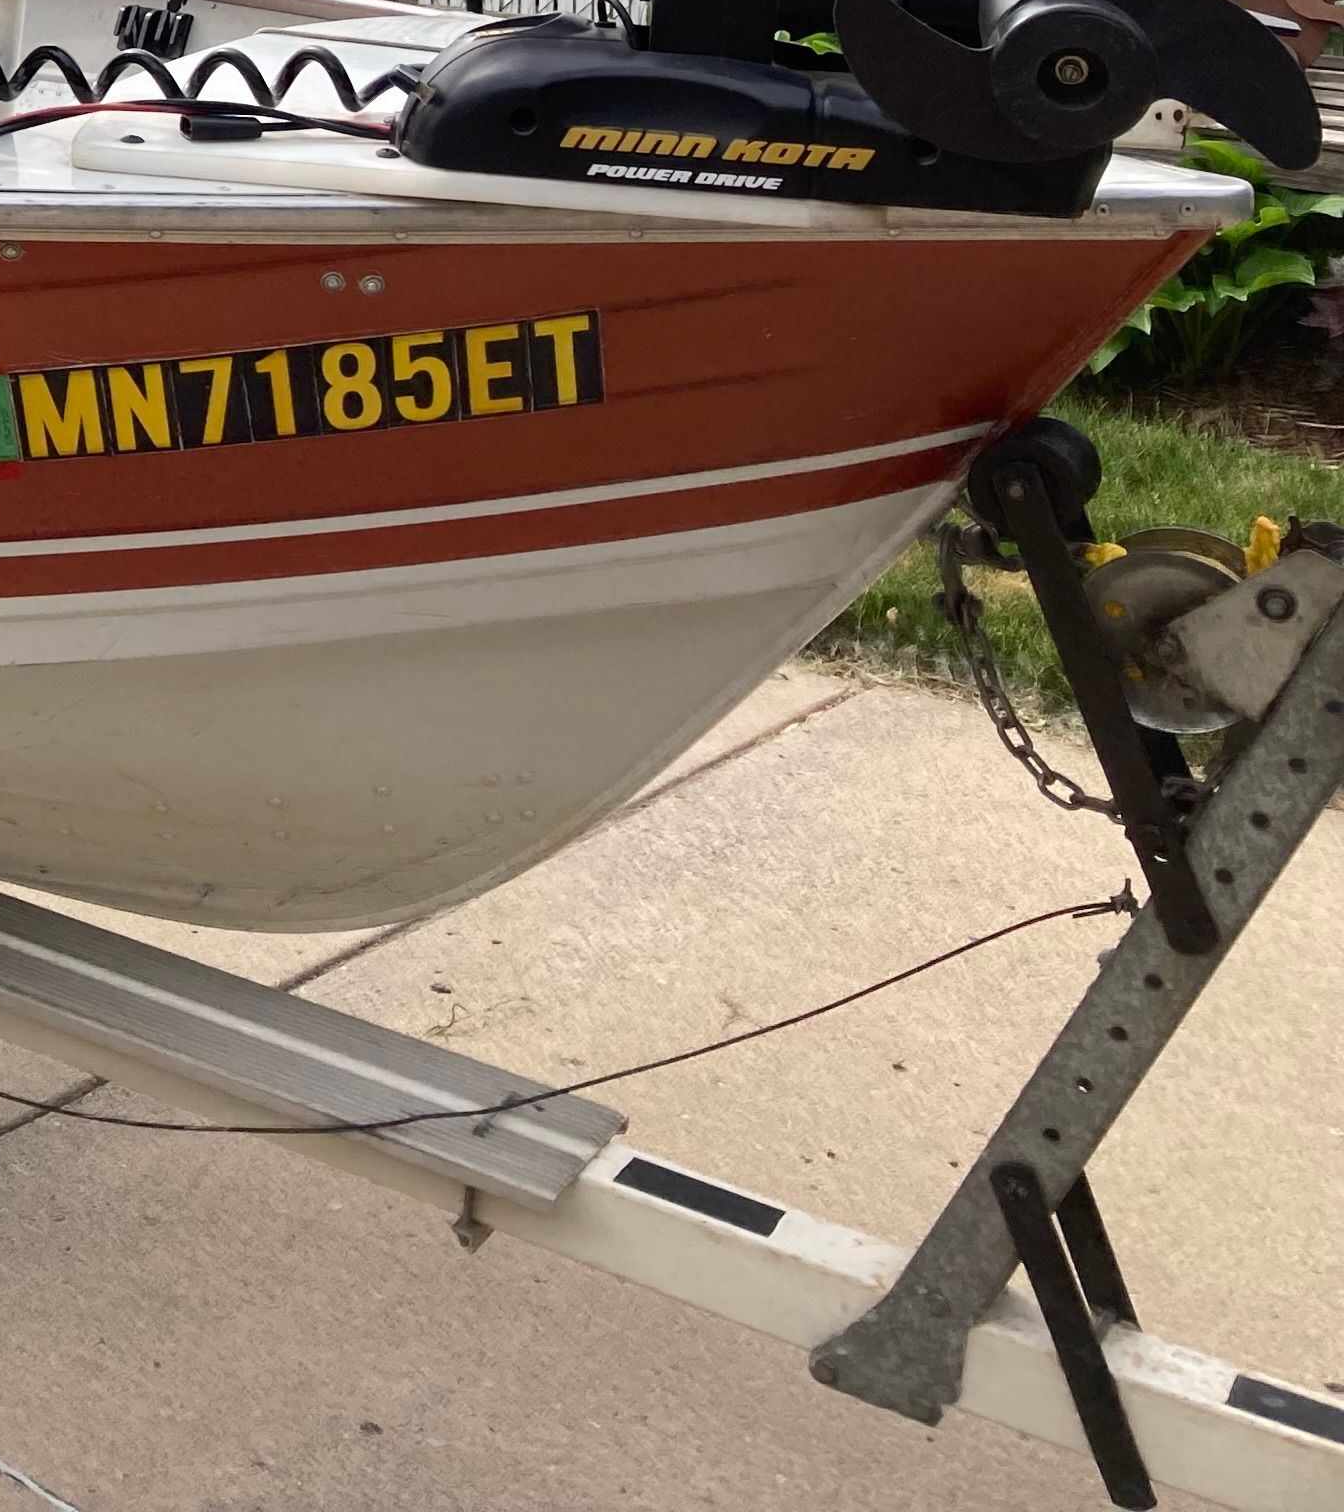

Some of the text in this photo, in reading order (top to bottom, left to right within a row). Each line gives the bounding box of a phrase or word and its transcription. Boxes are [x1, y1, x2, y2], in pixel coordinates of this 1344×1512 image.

[559, 125, 877, 171] MINN KOTA
[586, 163, 784, 191] POWER DRIVE
